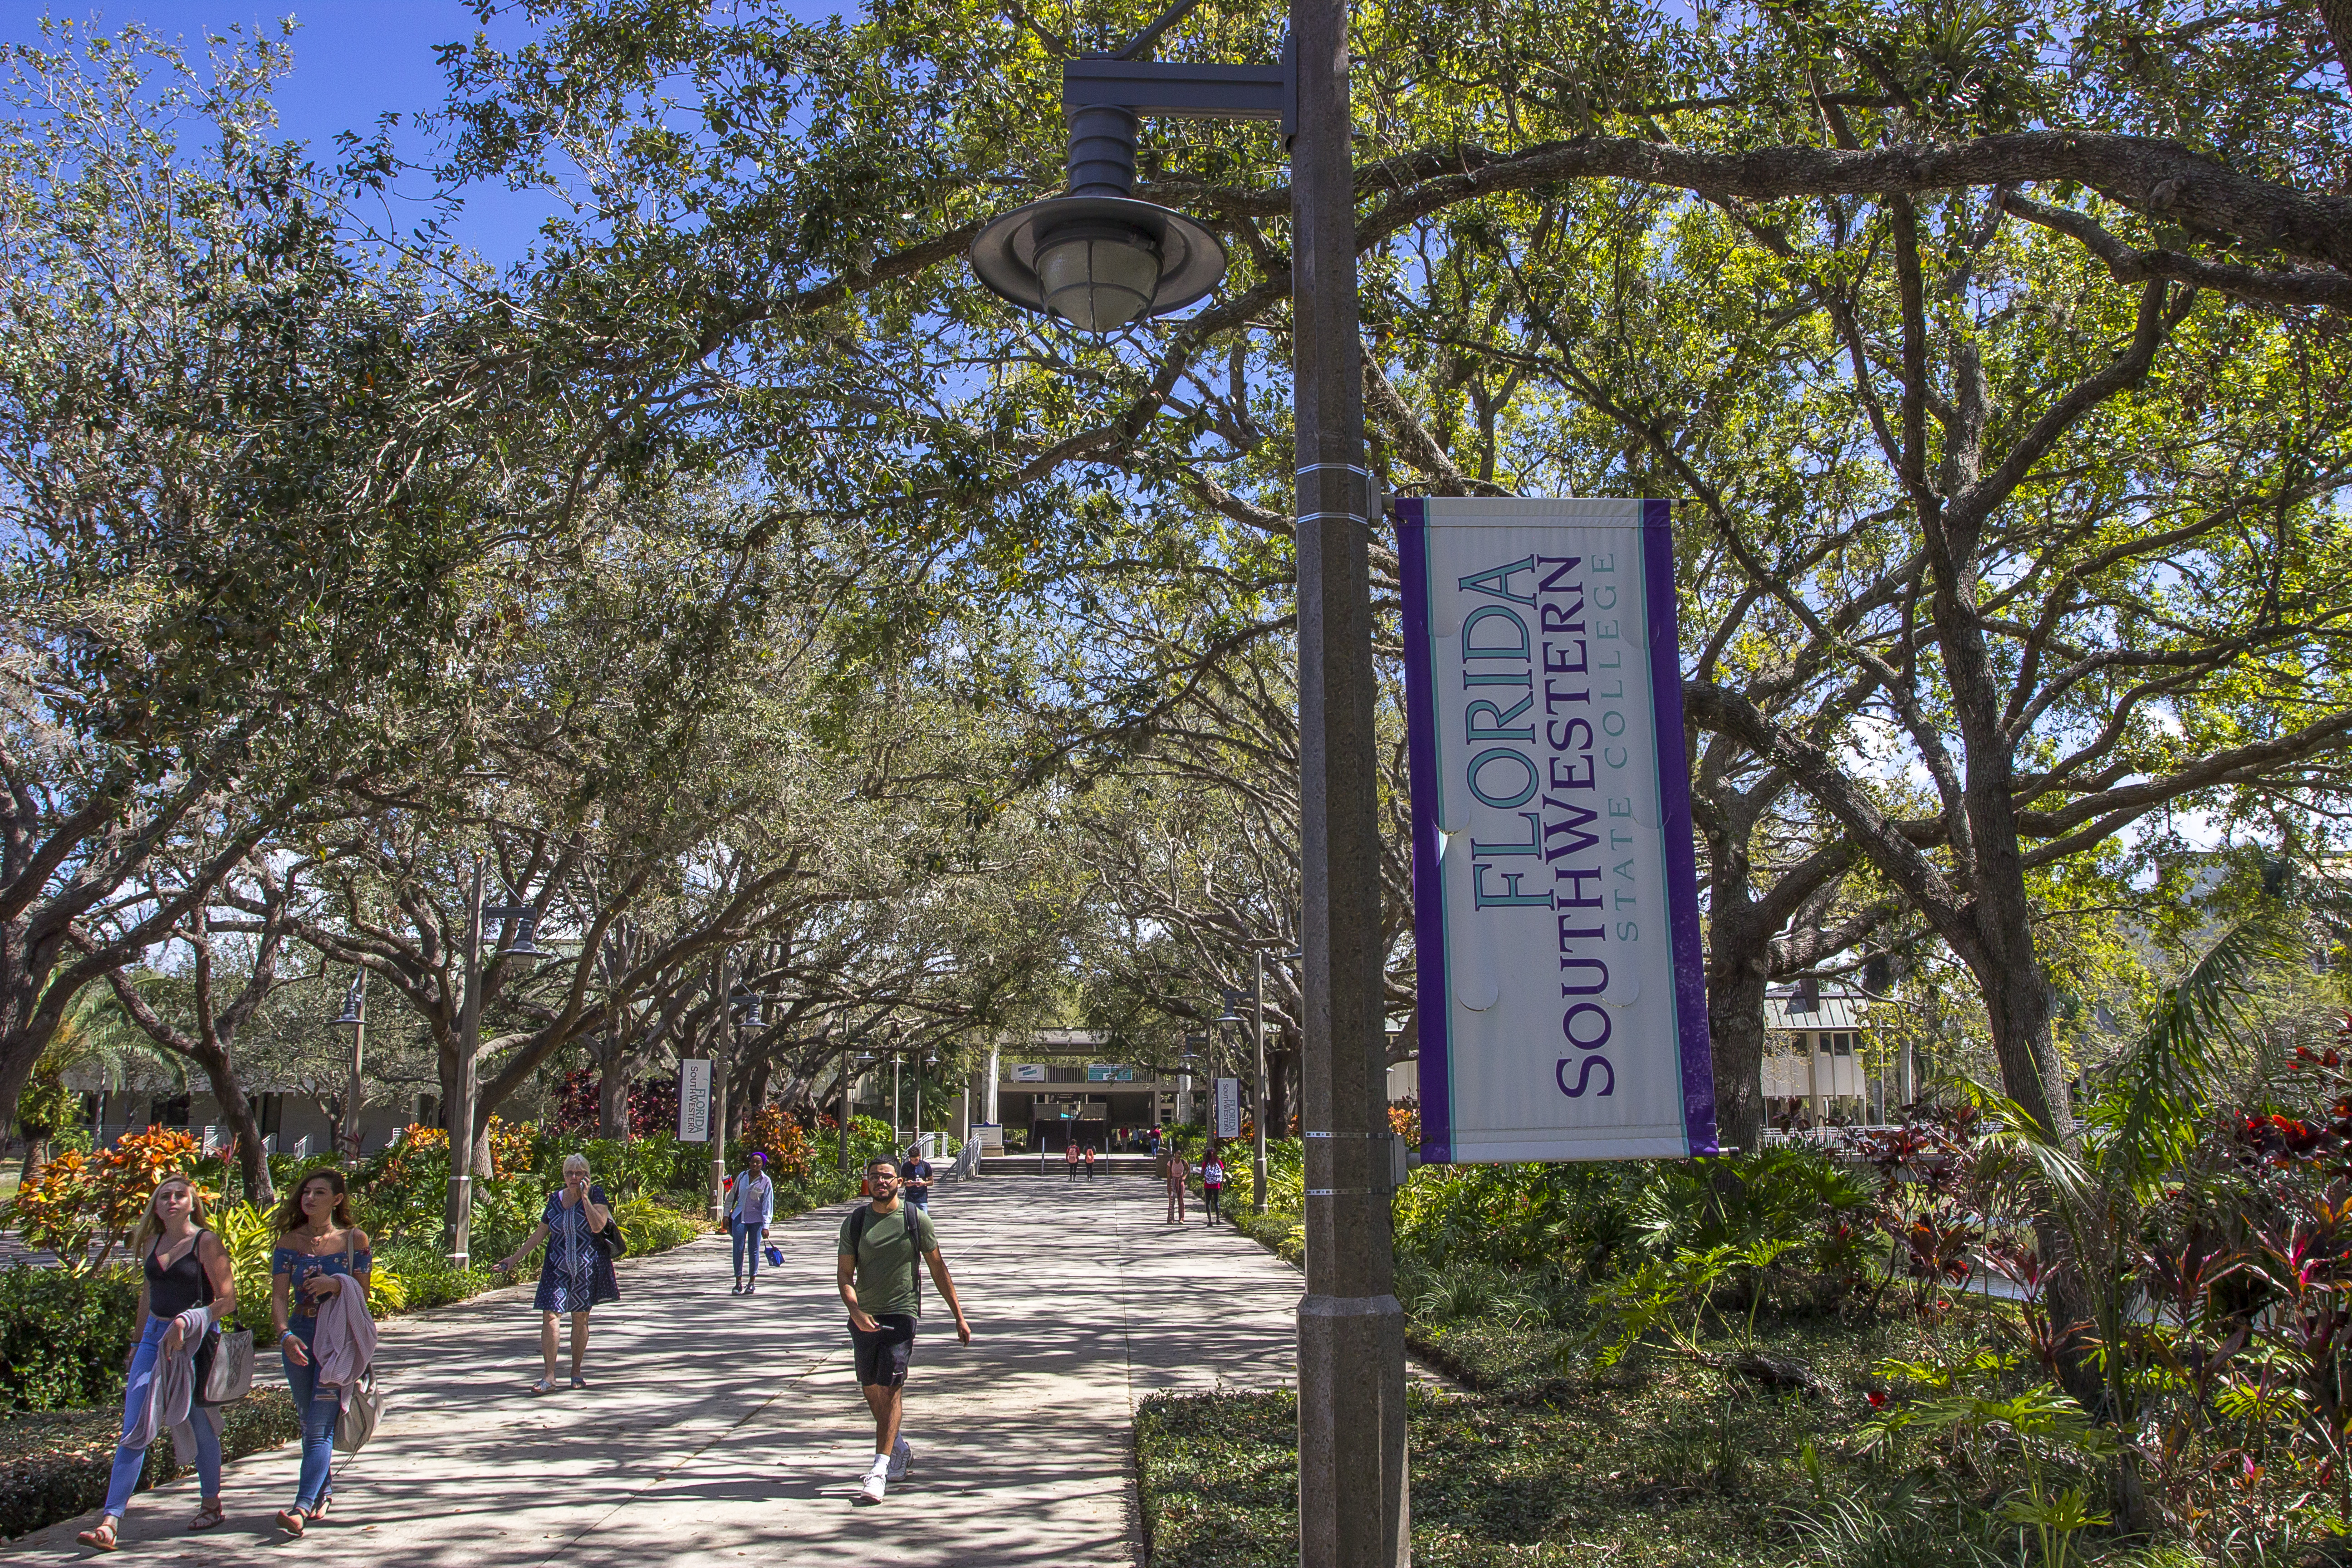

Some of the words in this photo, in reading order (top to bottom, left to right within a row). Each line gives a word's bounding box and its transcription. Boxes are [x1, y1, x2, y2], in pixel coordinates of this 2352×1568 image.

[1458, 554, 1555, 912] FLORIDA
[1591, 553, 1628, 769] COLLEGE
[1537, 554, 1615, 1098] SOUTHWESTERN
[1608, 797, 1638, 941] STATE
[687, 1066, 698, 1133] SOUTHWESTERN
[694, 1088, 706, 1133] FLORIDA
[1228, 1099, 1236, 1132] FLORIDA
